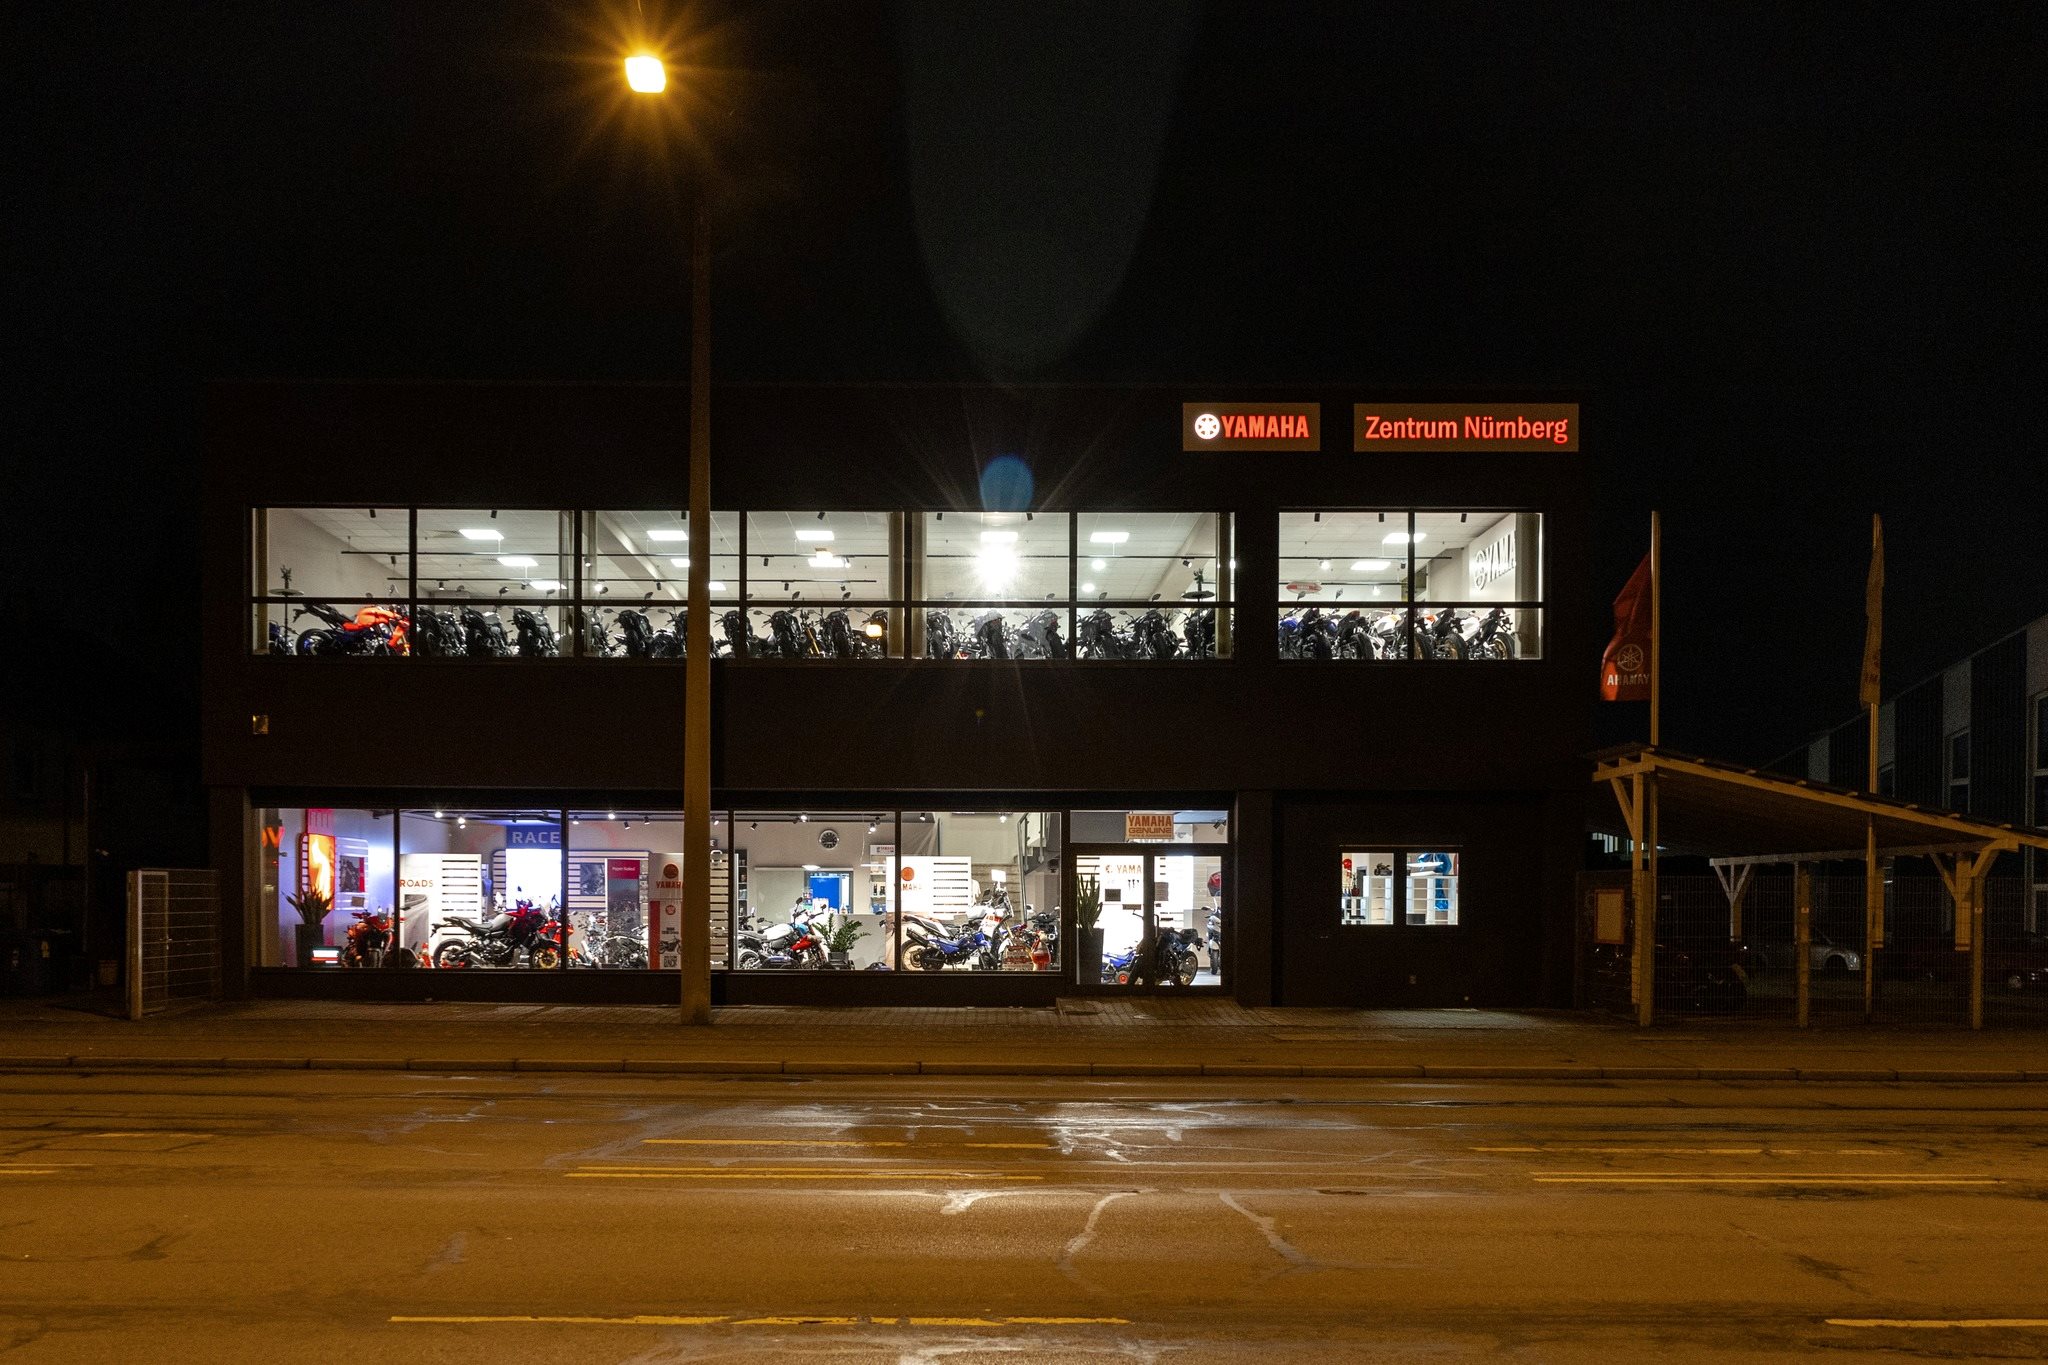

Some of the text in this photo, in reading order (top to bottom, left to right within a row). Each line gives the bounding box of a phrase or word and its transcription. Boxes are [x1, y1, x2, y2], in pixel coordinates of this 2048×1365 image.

[1221, 415, 1309, 438] YAMAHA
[1365, 415, 1568, 443] Zentrum Nürnberg
[1128, 815, 1172, 827] YAMAHA
[511, 831, 560, 844] RACE
[399, 879, 434, 888] ROADS
